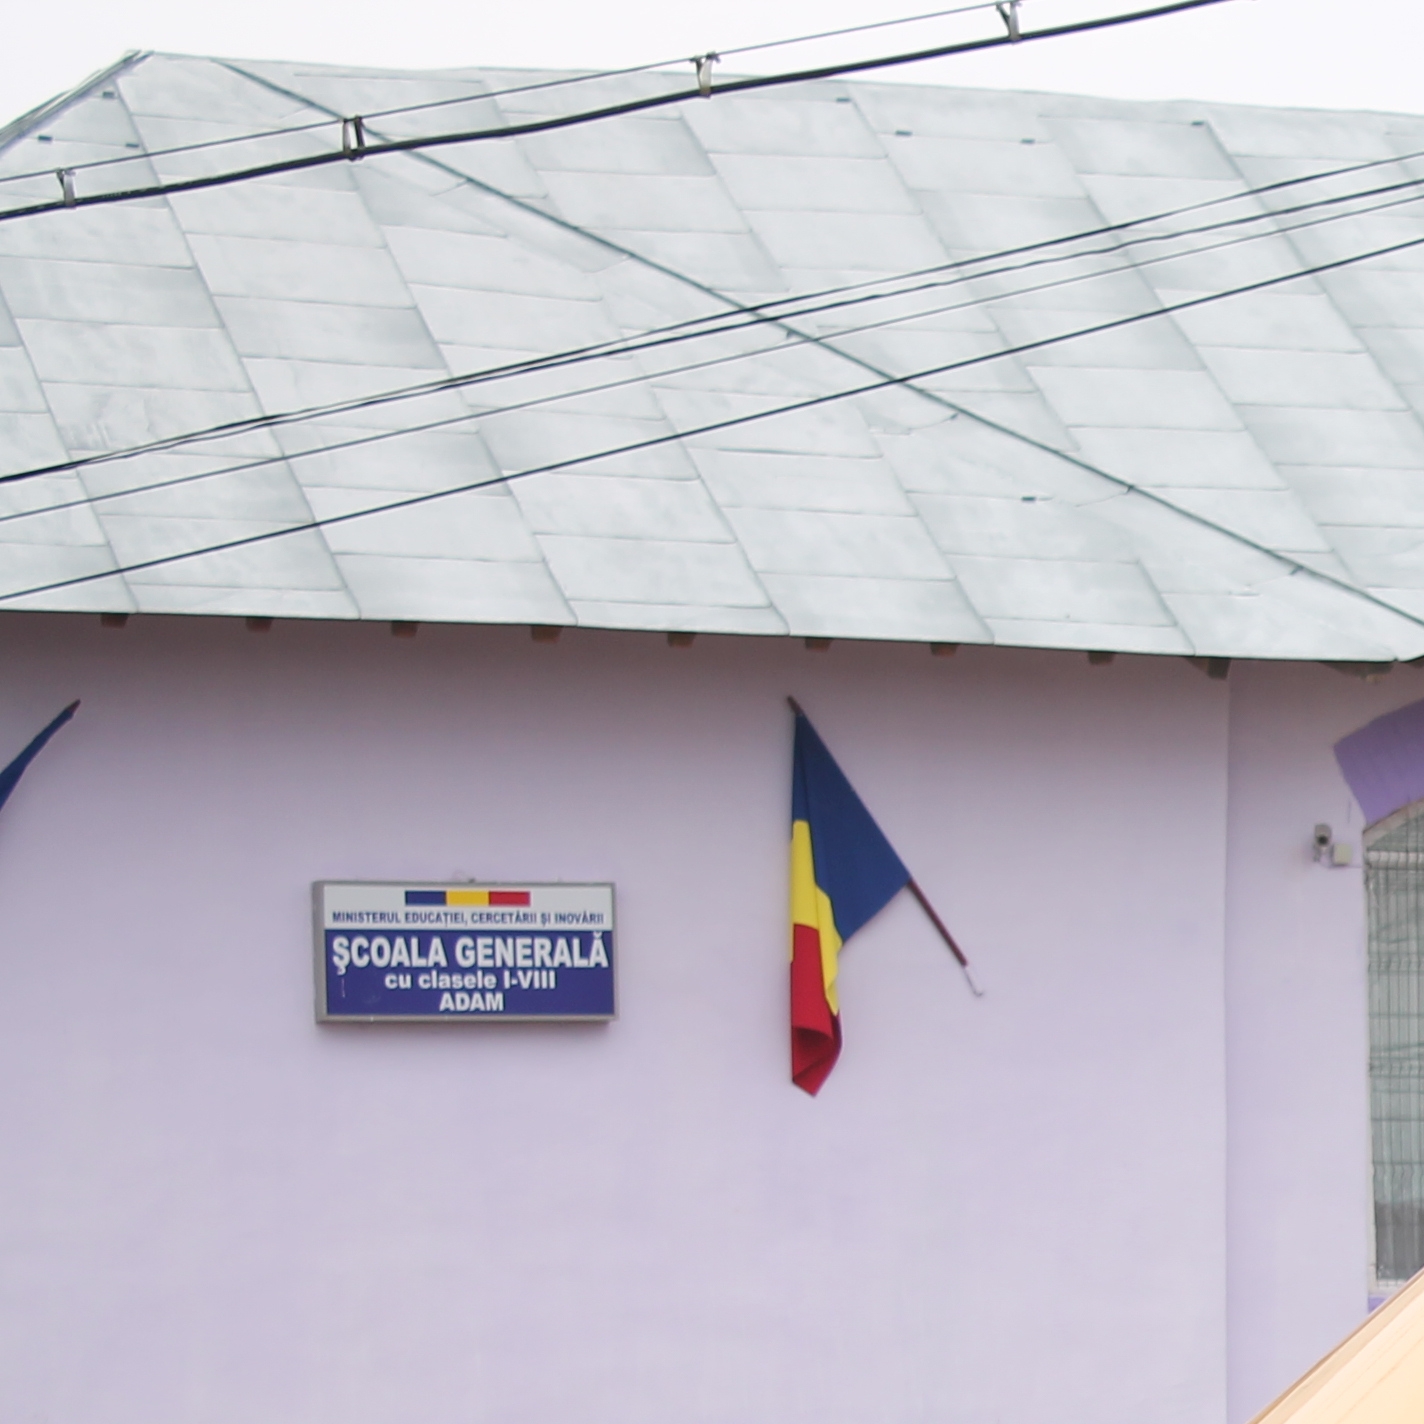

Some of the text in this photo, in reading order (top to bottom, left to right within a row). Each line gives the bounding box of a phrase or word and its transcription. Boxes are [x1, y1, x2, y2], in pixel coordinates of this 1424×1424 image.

[332, 911, 402, 924] MINISTERUL
[454, 930, 609, 969] GENERALĂ
[384, 969, 557, 990] cu clasele I-VIII
[439, 991, 504, 1012] ADAM
